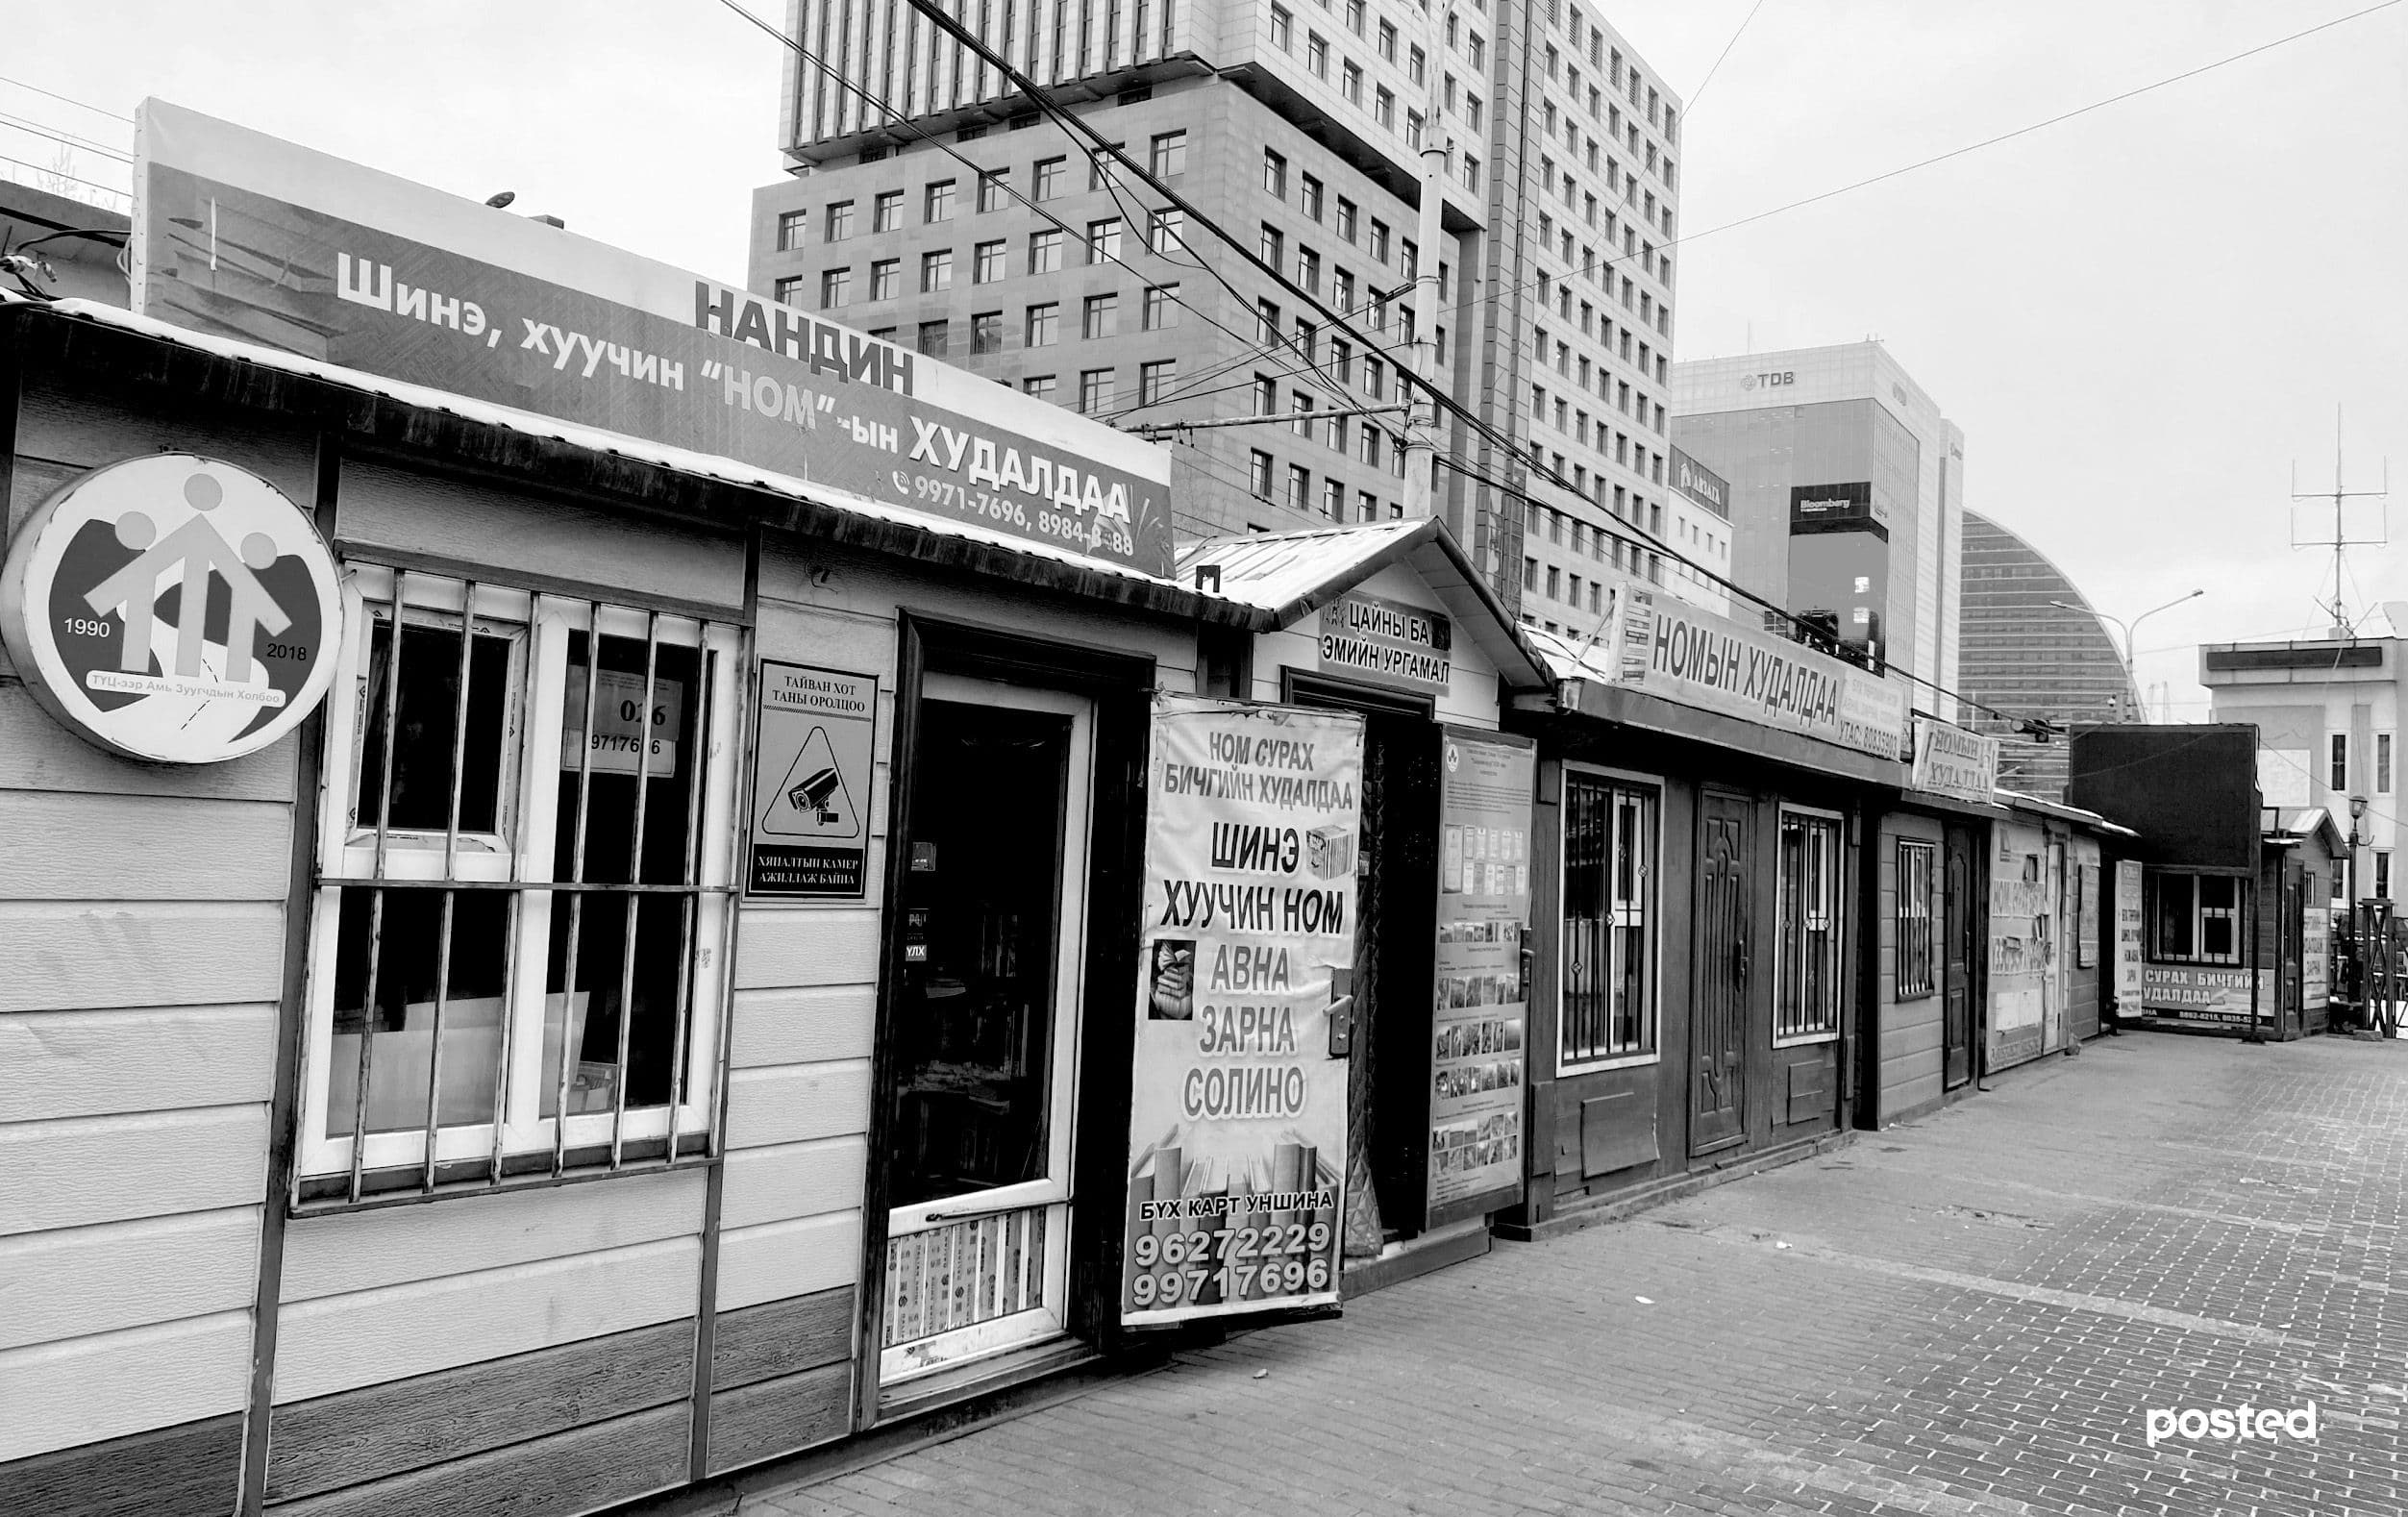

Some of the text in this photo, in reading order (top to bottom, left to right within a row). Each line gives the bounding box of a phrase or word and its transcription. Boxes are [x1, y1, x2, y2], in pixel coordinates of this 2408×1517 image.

[337, 252, 502, 347] Шинэ,
[520, 317, 684, 391] хуучин
[695, 281, 914, 396] НАНДИН
[1757, 371, 1794, 387] TDB
[909, 415, 1130, 524] ХУДАЛДАА
[915, 474, 1133, 557] 9971-7696, 8984-888
[1800, 498, 1849, 509] Bloomberg
[63, 617, 111, 638] 1990
[1349, 602, 1404, 638] ЦАЙНЫ
[266, 643, 308, 661] 2018
[1322, 634, 1450, 684] ЭМИЙН УРГАМАЛ
[1652, 614, 1741, 692] НОМЫН
[1744, 646, 1838, 728] ХУДАЛДАА
[146, 680, 172, 693] Амь
[237, 690, 280, 703] Холбоо
[772, 689, 865, 712] ТАНЫ ОРОЛЦОО
[783, 675, 856, 696] ТАЙВАН ХОТ
[1209, 732, 1314, 771] НОМ СУРАХ
[1165, 763, 1353, 813] БИЧГИЙН ХУДАЛДАА
[1211, 822, 1299, 874] ШИНЭ
[1160, 880, 1343, 933] ХУУЧИН НОМ
[1211, 944, 1289, 991] АВНА
[2145, 969, 2188, 984] СУРАХ
[2143, 986, 2210, 1005] УДАЛДАА
[1200, 1006, 1295, 1053] ЗАРНА
[1184, 1067, 1303, 1117] СОЛИНО
[1188, 1196, 1240, 1217] КАРТ
[1246, 1190, 1333, 1212] УНШИНА
[1134, 1222, 1330, 1267] 96272229
[1132, 1258, 1328, 1306] 99717696
